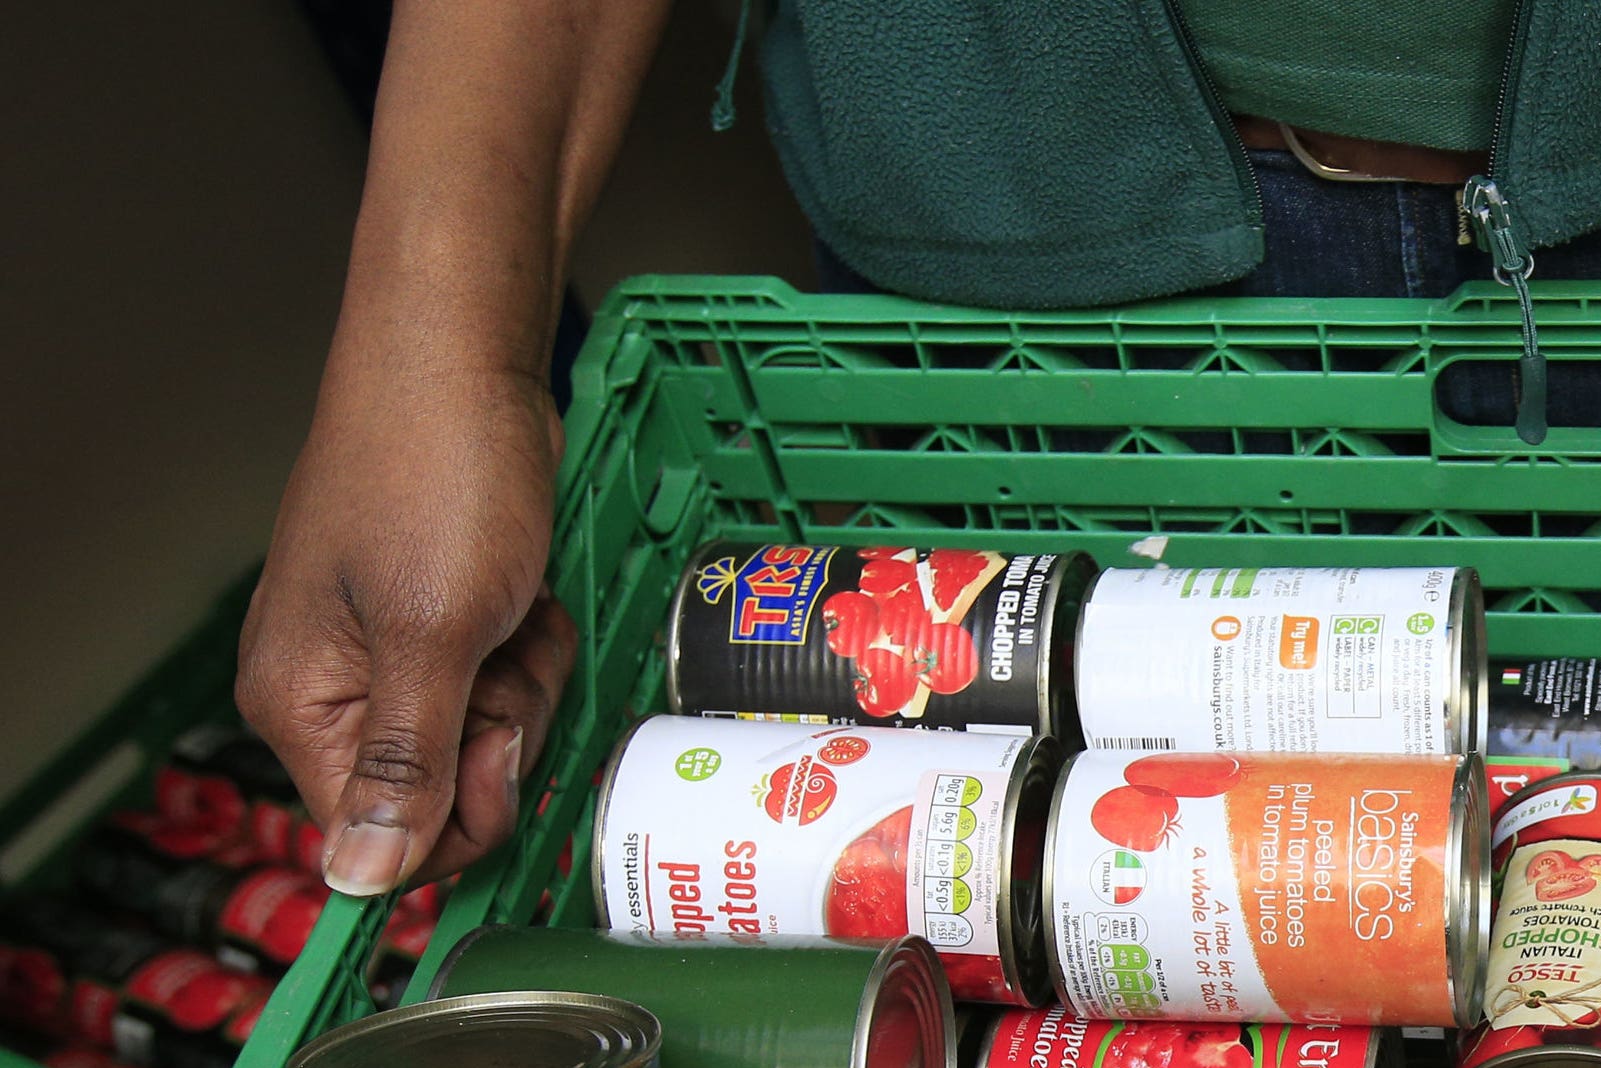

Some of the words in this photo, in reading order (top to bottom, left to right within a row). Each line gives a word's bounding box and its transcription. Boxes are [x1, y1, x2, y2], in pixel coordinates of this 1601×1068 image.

[1422, 571, 1443, 589] 400g
[739, 546, 813, 635] TRS
[1021, 575, 1045, 624] TOMATO
[991, 591, 1020, 680] CHOPPED
[1019, 629, 1034, 644] IN
[1291, 621, 1310, 639] Try
[1226, 646, 1234, 670] Want
[1293, 641, 1307, 664] me!
[1226, 672, 1233, 680] to
[1210, 646, 1225, 748] sainsburys.co.uk
[1226, 683, 1234, 701] find
[1226, 704, 1234, 720] out
[1227, 723, 1236, 751] more?
[1426, 741, 1433, 749] of
[695, 751, 709, 759] 5
[945, 779, 964, 803] 0.20g
[966, 786, 976, 796] 3%
[1267, 784, 1290, 799] in
[1290, 783, 1315, 830] plum
[1538, 801, 1551, 811] of
[941, 813, 957, 833] 5.6g
[961, 818, 970, 830] 6%
[1260, 804, 1285, 881] tomato
[938, 844, 953, 876] <0.1g
[1193, 847, 1206, 860] a
[1312, 820, 1336, 901] peeled
[1395, 813, 1419, 912] Sainsbury's
[623, 833, 641, 917] essentials
[1354, 790, 1412, 940] basics
[1102, 861, 1111, 893] ITALIAN
[937, 881, 951, 911] <0.5g
[957, 887, 966, 905] <1%
[1191, 866, 1207, 923] whole
[1286, 838, 1308, 947] tomatoes
[1215, 901, 1229, 915] A
[1254, 888, 1281, 944] juice
[1509, 905, 1538, 916] sauce
[1523, 915, 1600, 929] TOMATOES
[1193, 931, 1211, 956] lot
[1215, 922, 1231, 954] little
[1521, 946, 1582, 958] ITALIAN
[1197, 960, 1216, 977] of
[1219, 960, 1235, 977] bit
[1508, 969, 1580, 983] TESCO
[1222, 981, 1238, 992] of
